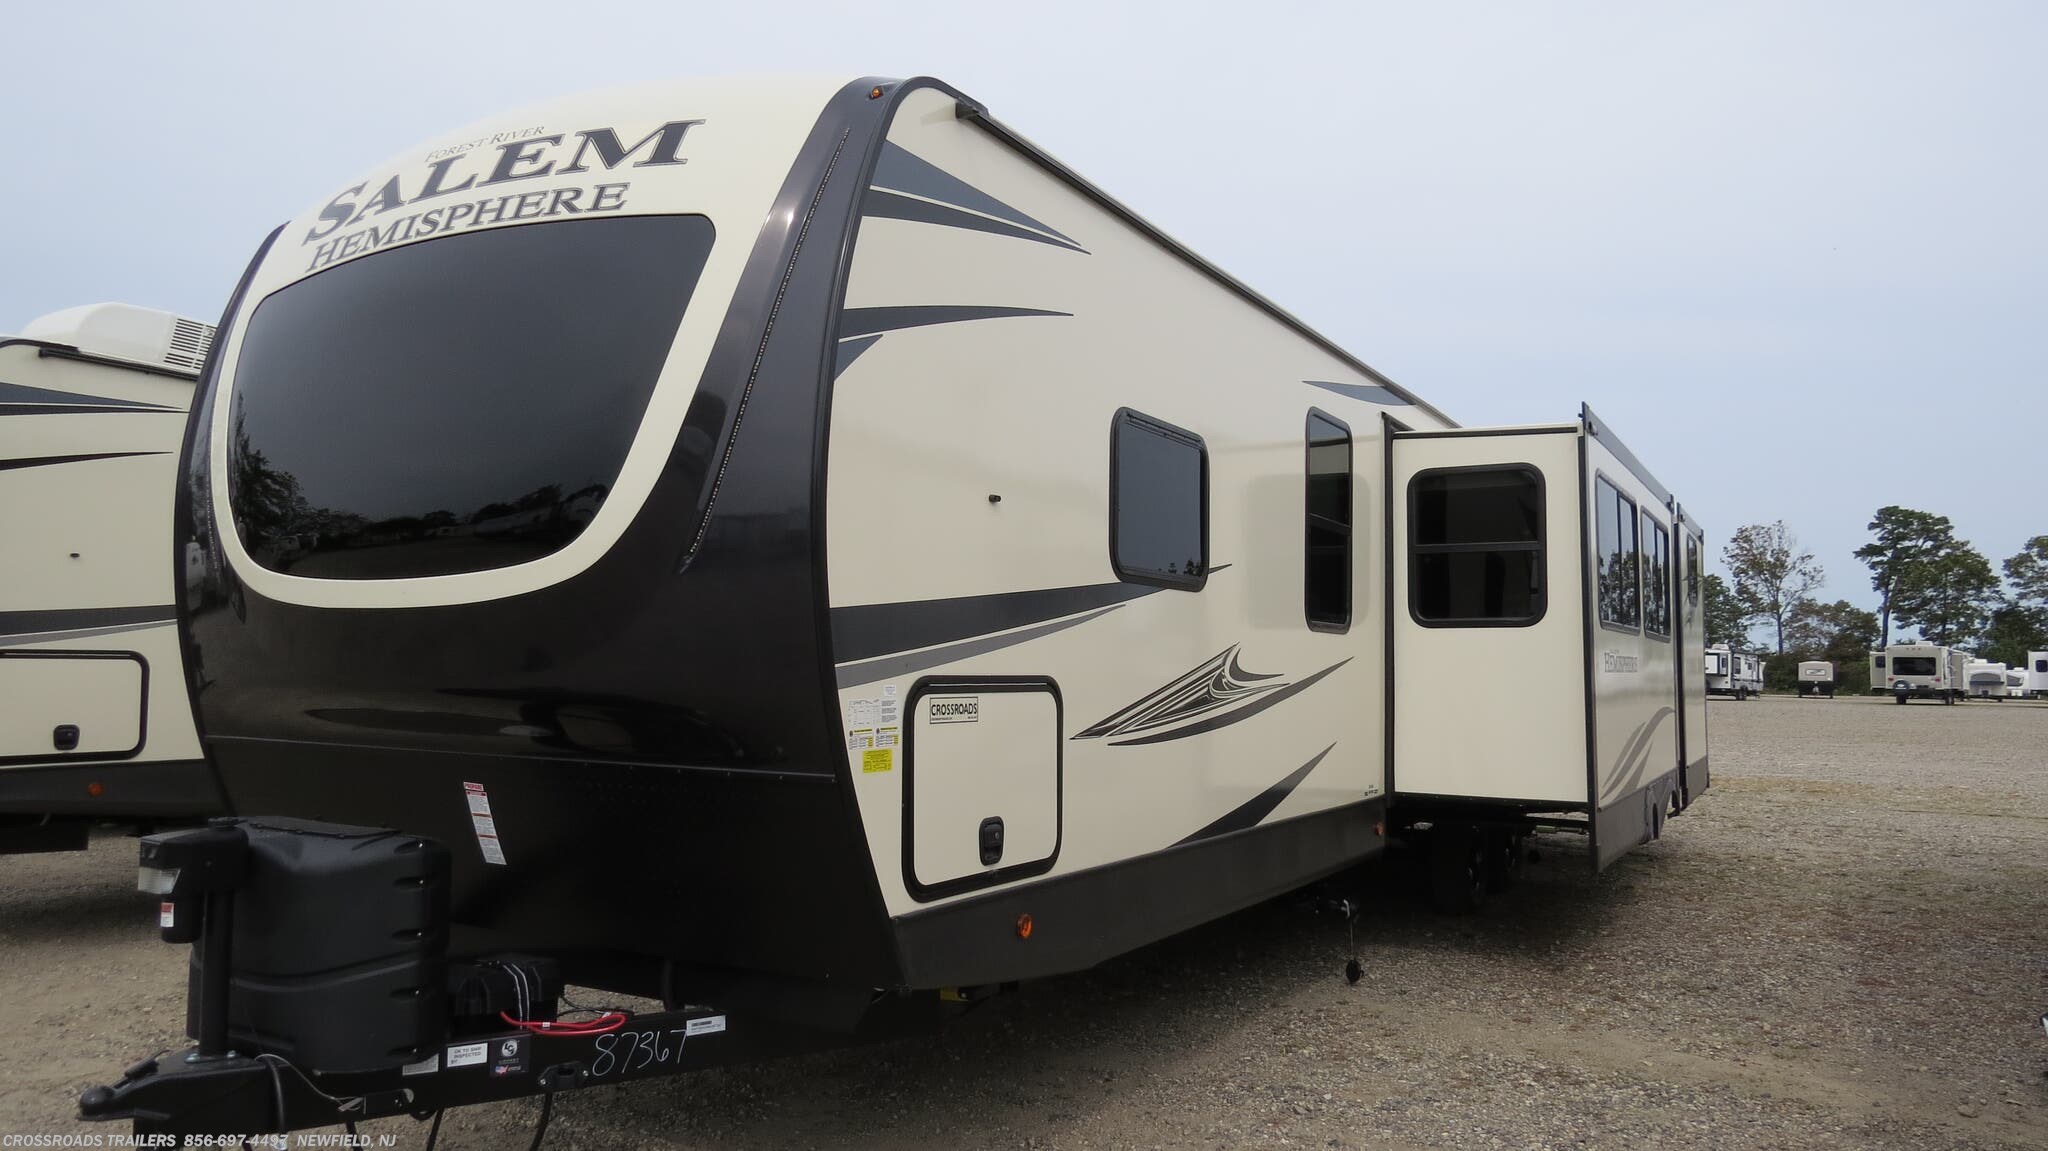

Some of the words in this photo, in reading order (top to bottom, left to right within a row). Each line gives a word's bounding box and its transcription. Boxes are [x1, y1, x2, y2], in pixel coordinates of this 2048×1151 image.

[425, 138, 488, 162] FOREST
[490, 126, 545, 144] RIVER
[302, 119, 707, 247] SALEM
[305, 182, 631, 273] HEMISPHERE
[931, 703, 977, 716] CROSSROADS
[592, 1030, 688, 1076] 87367
